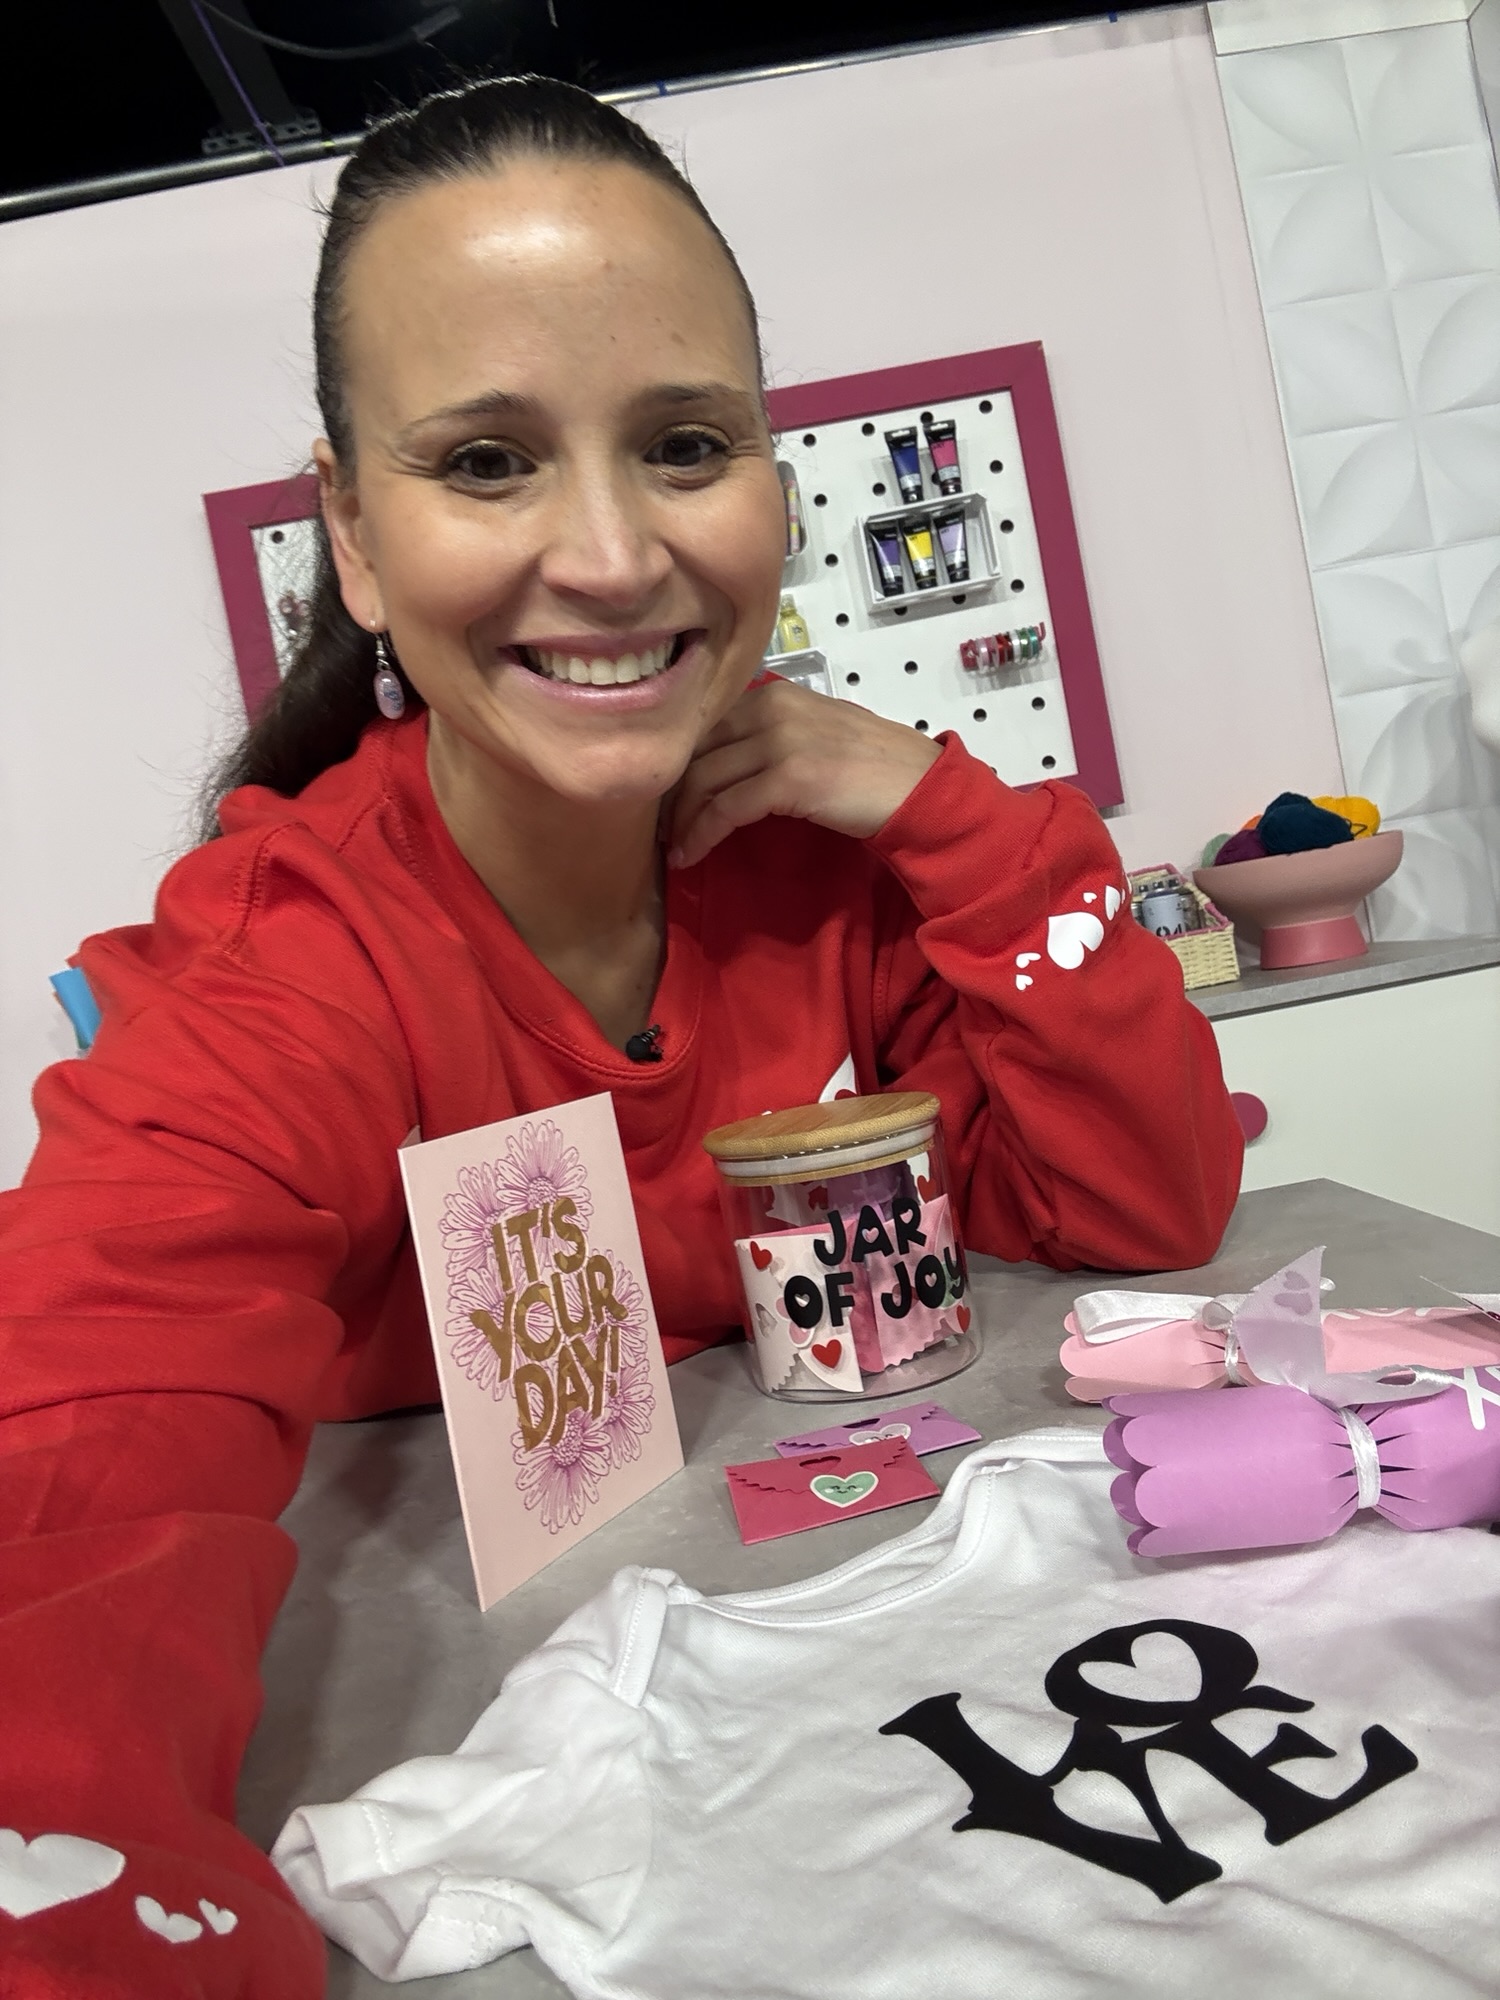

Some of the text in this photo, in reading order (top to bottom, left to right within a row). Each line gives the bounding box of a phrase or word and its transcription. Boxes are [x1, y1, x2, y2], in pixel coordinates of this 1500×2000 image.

[491, 1197, 588, 1291] IT'S
[814, 1199, 926, 1266] JAR
[470, 1255, 628, 1382] YOUR
[784, 1246, 965, 1329] OF JOY
[515, 1327, 620, 1451] DAY!
[879, 1618, 1418, 1904] LOVE
